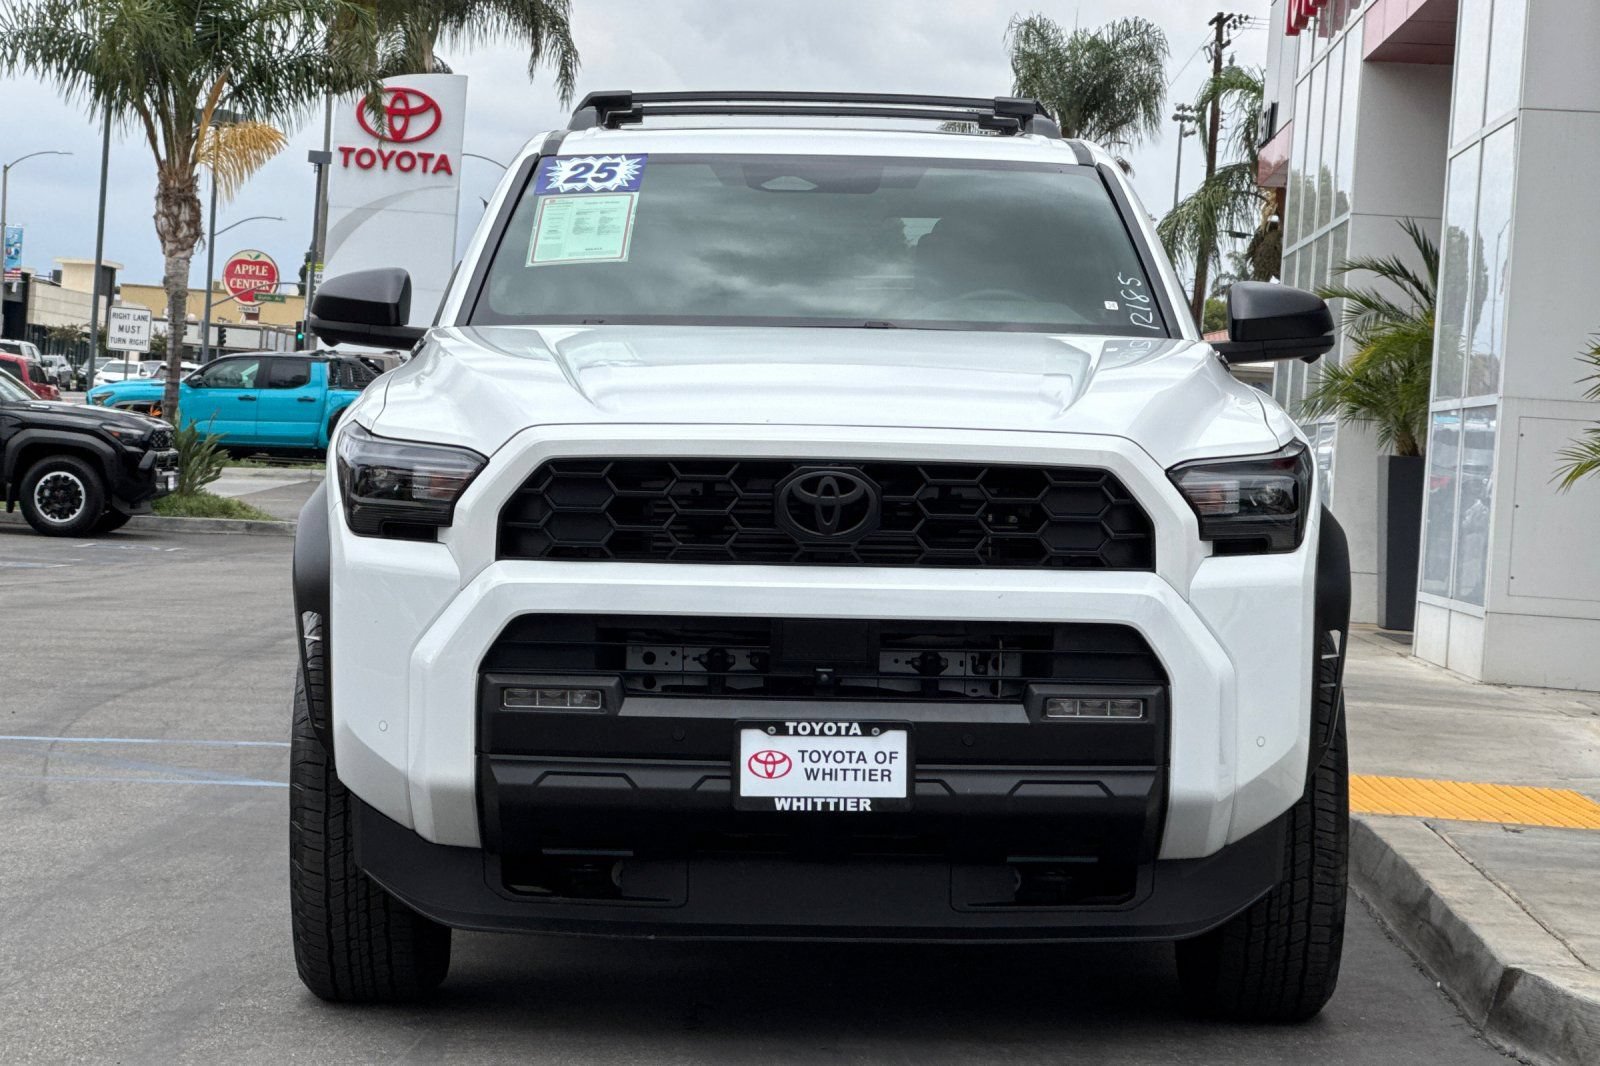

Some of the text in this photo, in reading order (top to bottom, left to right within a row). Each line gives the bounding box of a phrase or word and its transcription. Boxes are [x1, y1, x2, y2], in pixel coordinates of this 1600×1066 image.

[338, 146, 453, 176] TOYOTA
[562, 162, 621, 185] 25
[234, 263, 269, 276] APPLE
[229, 278, 270, 291] CENTER
[112, 312, 149, 322] RIGHT LANE
[117, 324, 141, 334] MUST
[110, 336, 147, 346] TURN RIGHT
[785, 721, 862, 736] TOYOTA
[798, 749, 899, 765] TOYOTA OF
[804, 767, 892, 782] WHITTIER
[774, 797, 872, 812] WHITTIER
